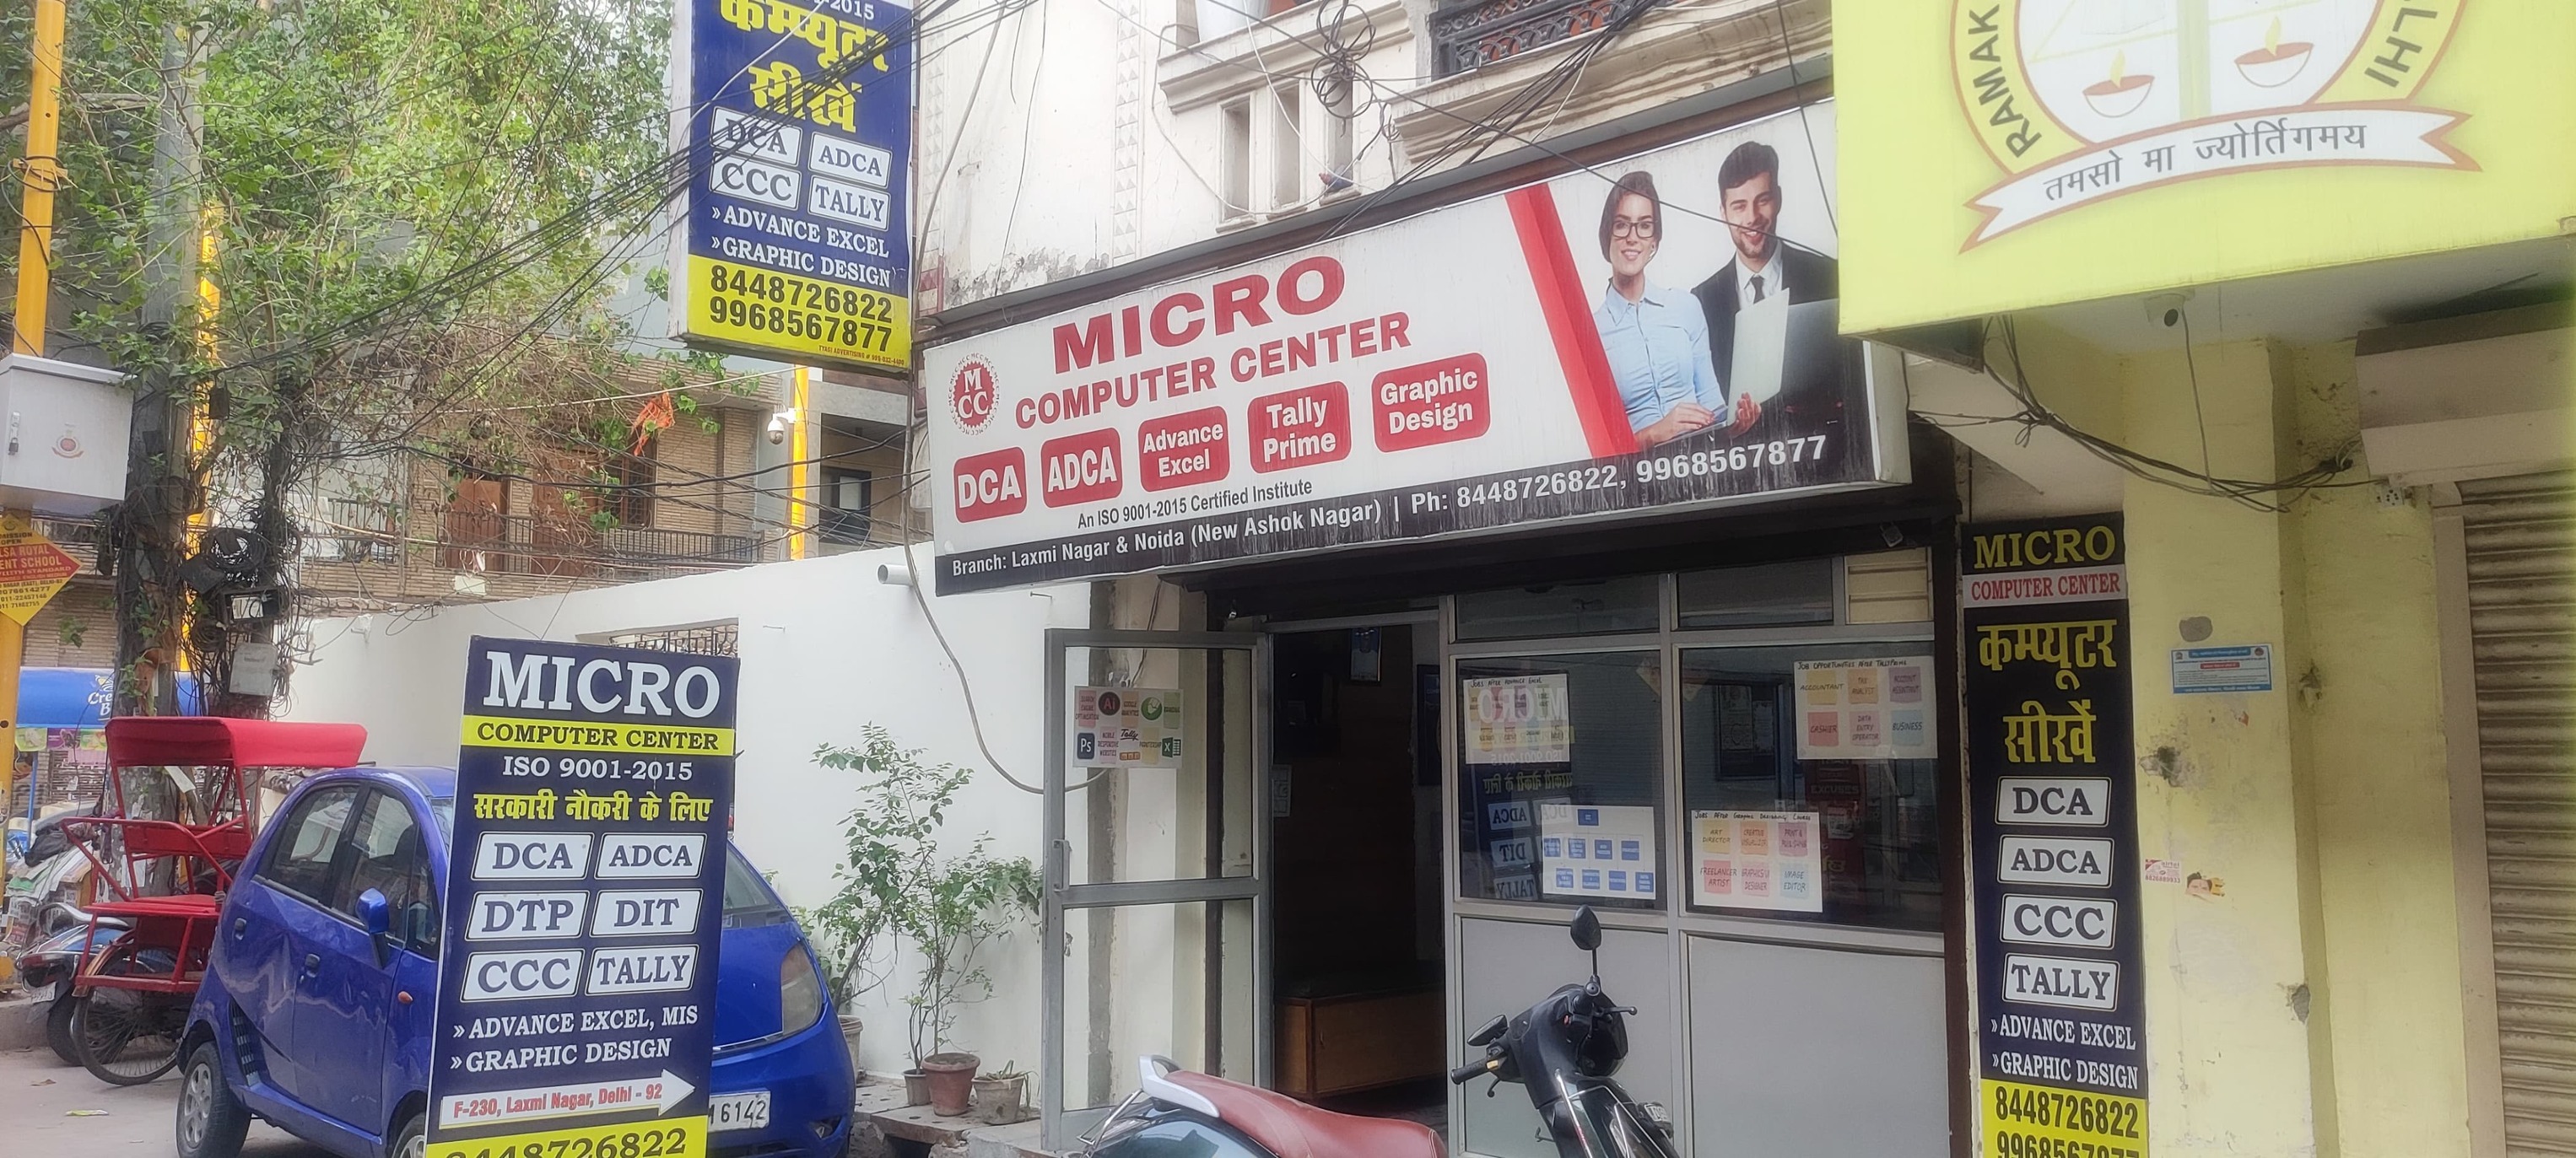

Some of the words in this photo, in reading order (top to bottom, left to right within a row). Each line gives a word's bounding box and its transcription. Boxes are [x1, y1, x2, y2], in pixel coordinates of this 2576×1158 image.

[2364, 7, 2438, 88] LHI
[727, 117, 787, 157] DCA
[818, 144, 883, 177] ADCA
[2044, 149, 2121, 201] तमसो
[2143, 144, 2175, 172] मा
[721, 163, 791, 202] CCC
[815, 185, 885, 223] TALLY
[723, 205, 820, 240] ADVANCE
[826, 229, 889, 258] EXCEL
[722, 236, 814, 273] GRAPHIC
[821, 257, 890, 288] DESIGN
[710, 264, 893, 323] 8448726822
[710, 296, 892, 352] 9968567877
[1052, 256, 1345, 374] MICRO
[834, 347, 865, 358] ADVERTISING
[1015, 356, 1218, 429] COMPUTER
[1230, 310, 1412, 383] CENTER
[964, 367, 982, 393] M
[1380, 369, 1478, 405] Graphic
[958, 390, 990, 419] CC
[1266, 396, 1328, 430] Tally
[1389, 401, 1473, 434] Design
[1142, 422, 1224, 455] Advance
[1263, 431, 1337, 463] Prime
[1047, 445, 1118, 493] ADCA
[1158, 449, 1211, 479] Excel
[957, 465, 1023, 509] DCA
[1077, 514, 1094, 530] An
[1097, 508, 1120, 526] ISO
[1122, 498, 1186, 522] 9001-2015
[1191, 488, 1250, 513] Certified
[1253, 477, 1313, 504] Institute
[953, 553, 1007, 577] Branch:
[1012, 544, 1058, 568] Laxmi
[1062, 537, 1110, 566] Nagar
[1115, 536, 1130, 553] &
[1135, 528, 1185, 552] Noida
[1191, 517, 1237, 548] (New
[1245, 504, 1304, 536] Ashok
[1310, 498, 1383, 531] Nagar)
[1412, 491, 1448, 514] Ph:
[1457, 466, 1627, 508] 8448726822,
[1637, 435, 1828, 484] 9968567877
[0, 547, 16, 557] LSA
[19, 544, 50, 557] ROYAL
[0, 558, 17, 569] ENT
[21, 556, 62, 568] SCHOOL
[1974, 525, 2116, 569] MICRO
[1971, 577, 2054, 601] COMPUTER
[2057, 572, 2120, 596] CENTER
[88, 692, 113, 704] Cre
[483, 650, 720, 718] MICRO
[477, 722, 618, 746] COMPUTER
[626, 730, 719, 750] CENTER
[1121, 729, 1139, 741] Tally
[1892, 722, 1923, 730] BUSINESS
[2002, 699, 2097, 763] सीखें
[1081, 738, 1092, 752] Ps
[502, 756, 550, 777] ISO
[560, 758, 693, 780] 9001-2015
[473, 788, 559, 820] सरकारी
[564, 788, 632, 821] नौकरी
[640, 790, 662, 821] के
[669, 790, 714, 822] लिए
[2012, 787, 2093, 816] DCA
[492, 843, 573, 870] DCA
[608, 845, 692, 867] ADCA
[1700, 867, 1737, 876] FREELANCER
[2011, 848, 2101, 875] ADCA
[1708, 878, 1730, 886] ARTIST
[1784, 882, 1806, 892] EDITOR
[482, 899, 574, 933] DTP
[614, 898, 679, 927] DIT
[2013, 904, 2105, 940] CCC
[478, 958, 570, 993] CCC
[597, 954, 690, 985] TALLY
[2012, 964, 2110, 1001] TALLY
[468, 1012, 575, 1039] ADVANCE
[581, 1009, 655, 1031] EXCEL,
[662, 1004, 699, 1026] MIS
[2000, 1015, 2076, 1044] ADVANCE
[2080, 1021, 2136, 1051] EXCEL
[466, 1045, 577, 1072] GRAPHIC
[586, 1038, 672, 1063] DESIGN
[2001, 1051, 2071, 1083] GRAPHIC
[2076, 1059, 2139, 1091] DESIGN
[453, 1096, 502, 1118] F-230,
[506, 1094, 547, 1114] Laxmi
[550, 1088, 594, 1110] Nagar,
[598, 1085, 632, 1103] Delhi
[645, 1083, 662, 1100] 92
[721, 1100, 766, 1124] 6142
[1995, 1085, 2140, 1139] 8448726822
[446, 1128, 686, 1158] 8726822
[1997, 1131, 2140, 1158] 996856
